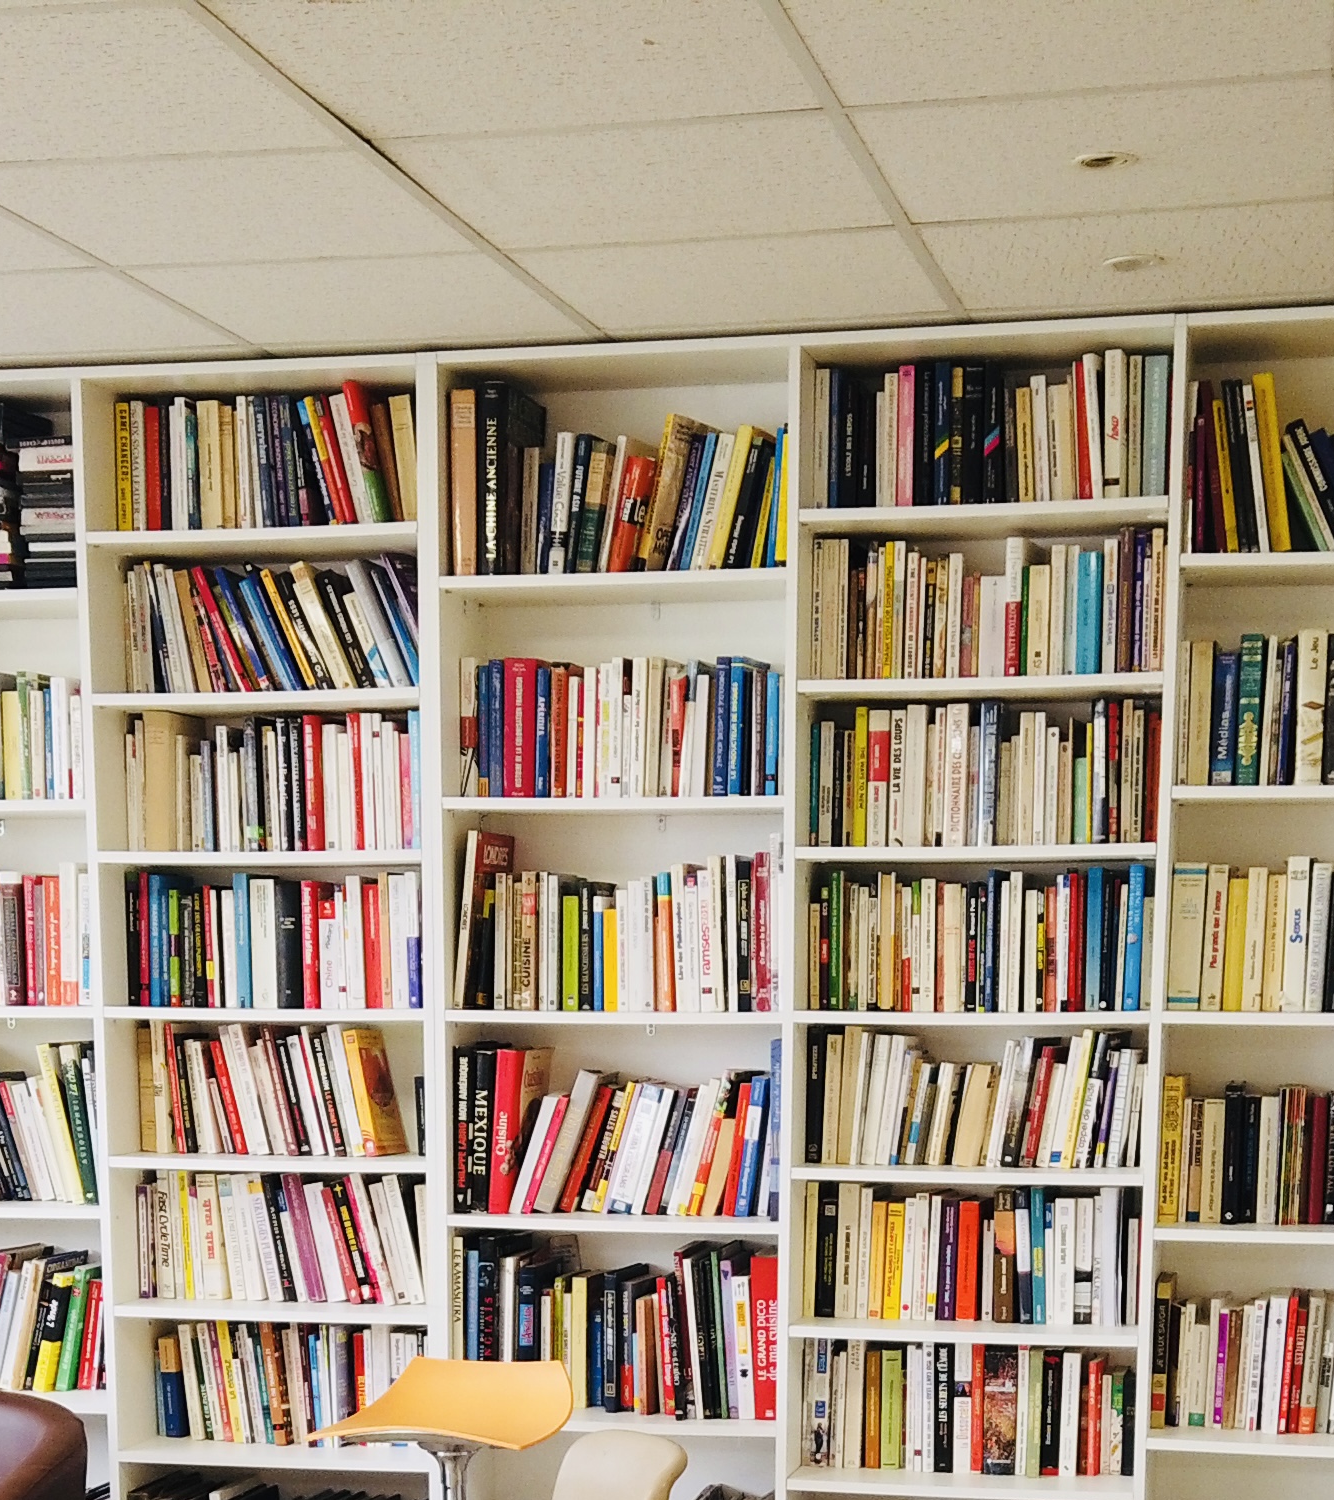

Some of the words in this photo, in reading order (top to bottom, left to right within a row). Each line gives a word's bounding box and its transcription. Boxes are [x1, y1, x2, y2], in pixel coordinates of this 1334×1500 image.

[485, 418, 497, 489] ANCIENNE
[485, 492, 497, 537] CHINE
[486, 540, 497, 559] LA
[893, 718, 903, 745] LOUPS
[1217, 711, 1229, 759] Médias
[893, 748, 901, 763] DES
[893, 766, 901, 780] VIE
[892, 783, 900, 793] LA
[521, 938, 531, 987] CUISINE
[521, 991, 530, 1007] LA
[457, 1057, 468, 1100] AMÉRIQUE
[1083, 1083, 1095, 1107] l'Inde
[458, 1101, 467, 1120] MON
[1081, 1109, 1089, 1119] de
[458, 1122, 467, 1149] LABRO
[473, 1090, 488, 1176] MEXIQUE
[495, 1111, 507, 1155] Cuisine
[1076, 1123, 1088, 1154] L'appel
[458, 1151, 466, 1187] PHILIPPE
[157, 1191, 168, 1212] Fast
[159, 1215, 170, 1241] Cycle
[160, 1242, 170, 1267] Time
[756, 1300, 766, 1326] DICO
[767, 1300, 777, 1340] cuisine
[757, 1330, 766, 1366] GRAND
[769, 1345, 777, 1362] ma
[756, 1370, 766, 1381] LE
[767, 1366, 777, 1380] de
[939, 1373, 948, 1381] DE
[938, 1383, 948, 1409] SECRETS
[938, 1410, 947, 1421] LES
